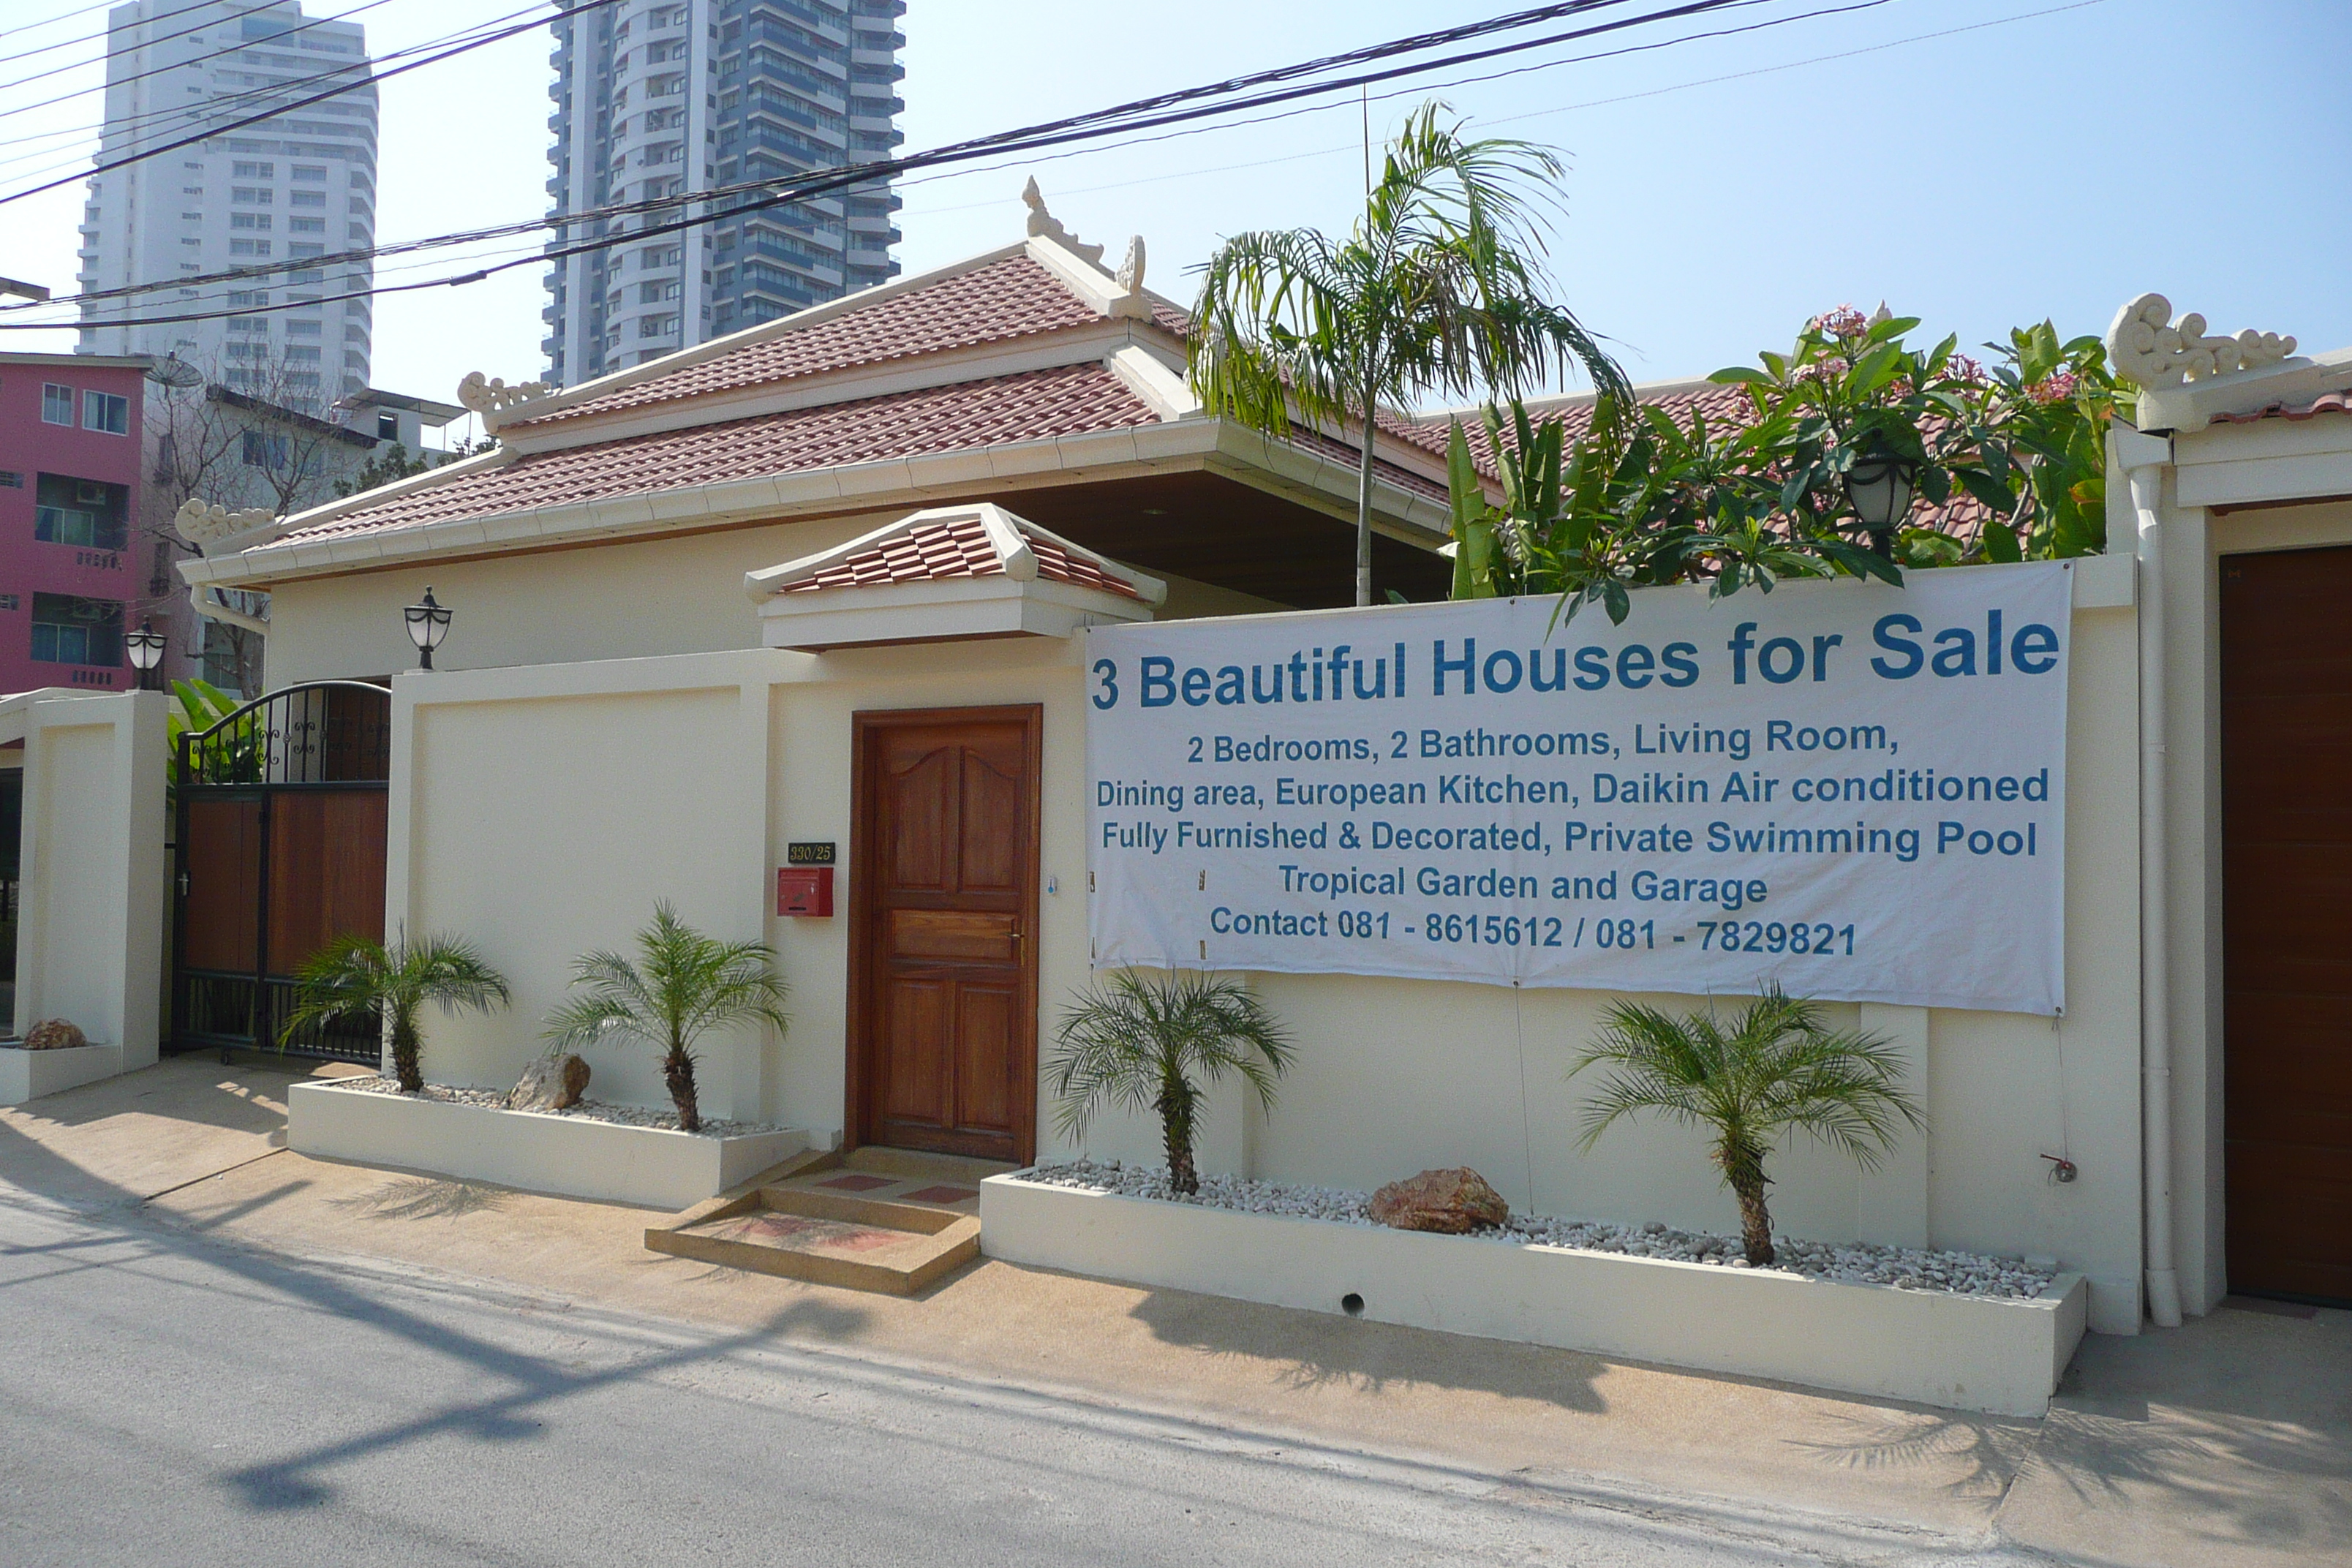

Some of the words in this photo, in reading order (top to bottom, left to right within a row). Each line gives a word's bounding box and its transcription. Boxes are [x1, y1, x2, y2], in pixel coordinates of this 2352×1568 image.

[1093, 658, 1119, 710] 3
[1141, 641, 1406, 708] Beautiful
[1433, 637, 1700, 696] Houses
[1727, 622, 1843, 685] for
[1871, 608, 2061, 680] Sale
[1188, 736, 1204, 763] 2
[1214, 734, 1379, 764] Bedrooms,
[1391, 730, 1408, 759] 2
[1420, 727, 1621, 760] Bathrooms,
[1635, 723, 1752, 760] Living
[1768, 720, 1899, 756] Room,
[1098, 780, 1184, 813] Dining
[1194, 784, 1264, 810] area,
[1276, 777, 1426, 812] European
[1439, 774, 1580, 807] Kitchen,
[1593, 772, 1709, 804] Daikin
[1721, 770, 1780, 803] Air
[1791, 768, 2049, 802] conditioned
[790, 845, 832, 862] 330/25
[1103, 821, 1169, 854] Fully
[1177, 821, 1327, 850] Furnished
[1338, 821, 1361, 850] &
[1371, 821, 1552, 856] Decorated,
[1564, 821, 1694, 853] Private
[1706, 821, 1921, 862] Swimming
[1937, 821, 2037, 856] Pool
[1278, 864, 1405, 900] Tropical
[1416, 866, 1539, 899] Garden
[1550, 870, 1618, 900] and
[1631, 870, 1768, 911] Garage
[1210, 906, 1329, 938] Contact
[1338, 910, 1390, 940] 081
[1404, 926, 1417, 934] -
[1426, 913, 1563, 949] 8615612
[1573, 917, 1586, 949] /
[1596, 918, 1656, 949] 081
[1697, 920, 1856, 957] 7829821
